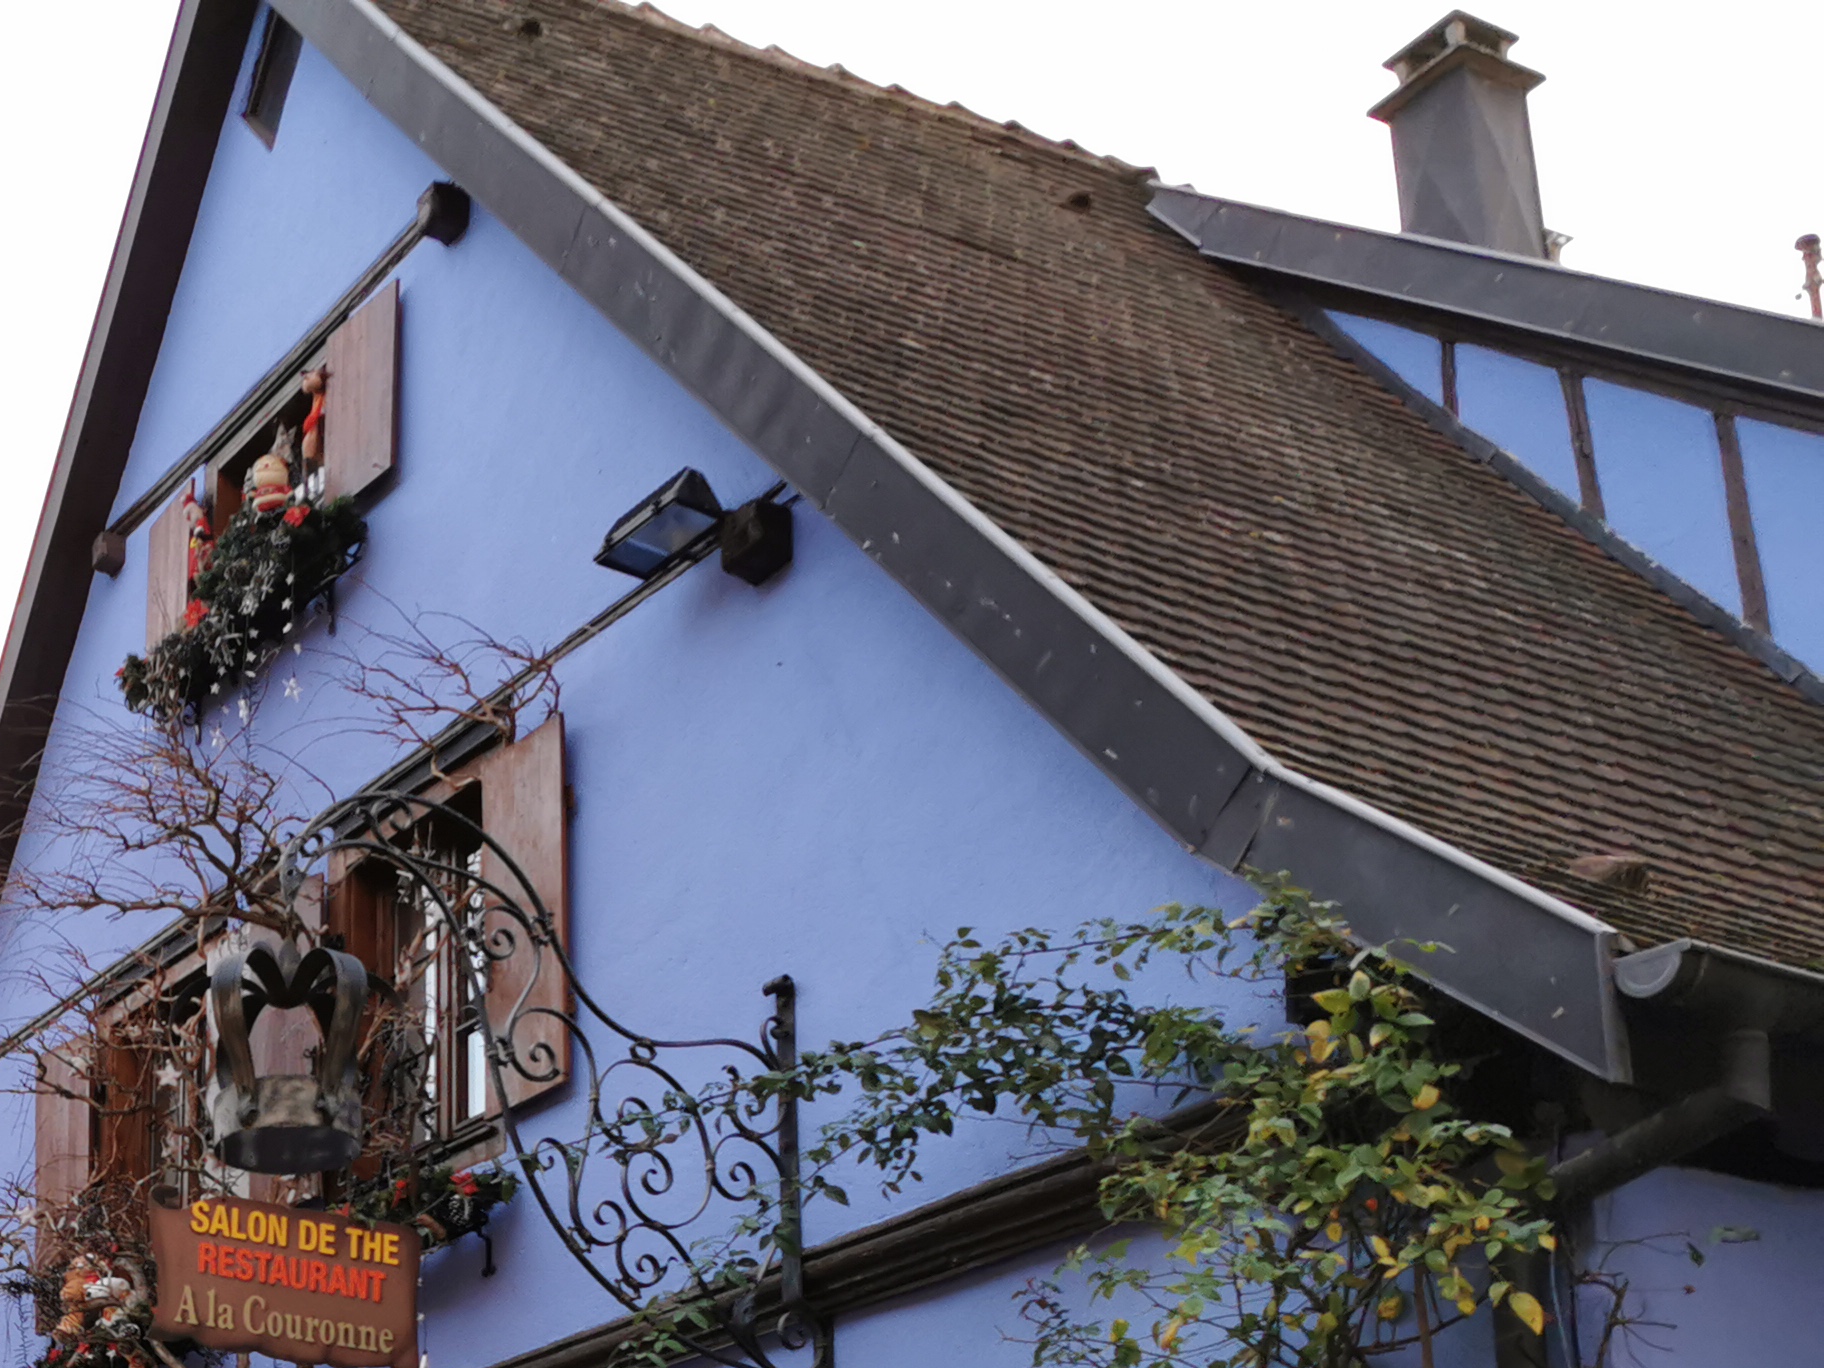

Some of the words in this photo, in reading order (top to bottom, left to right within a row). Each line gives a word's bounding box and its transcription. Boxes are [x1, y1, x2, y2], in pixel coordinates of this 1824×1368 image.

[190, 1201, 287, 1246] SALON
[298, 1219, 336, 1255] DE
[345, 1226, 400, 1265] THE
[198, 1242, 387, 1302] RESTAURANT
[174, 1285, 199, 1326] A
[207, 1288, 234, 1329] la
[243, 1295, 394, 1353] Couronne
